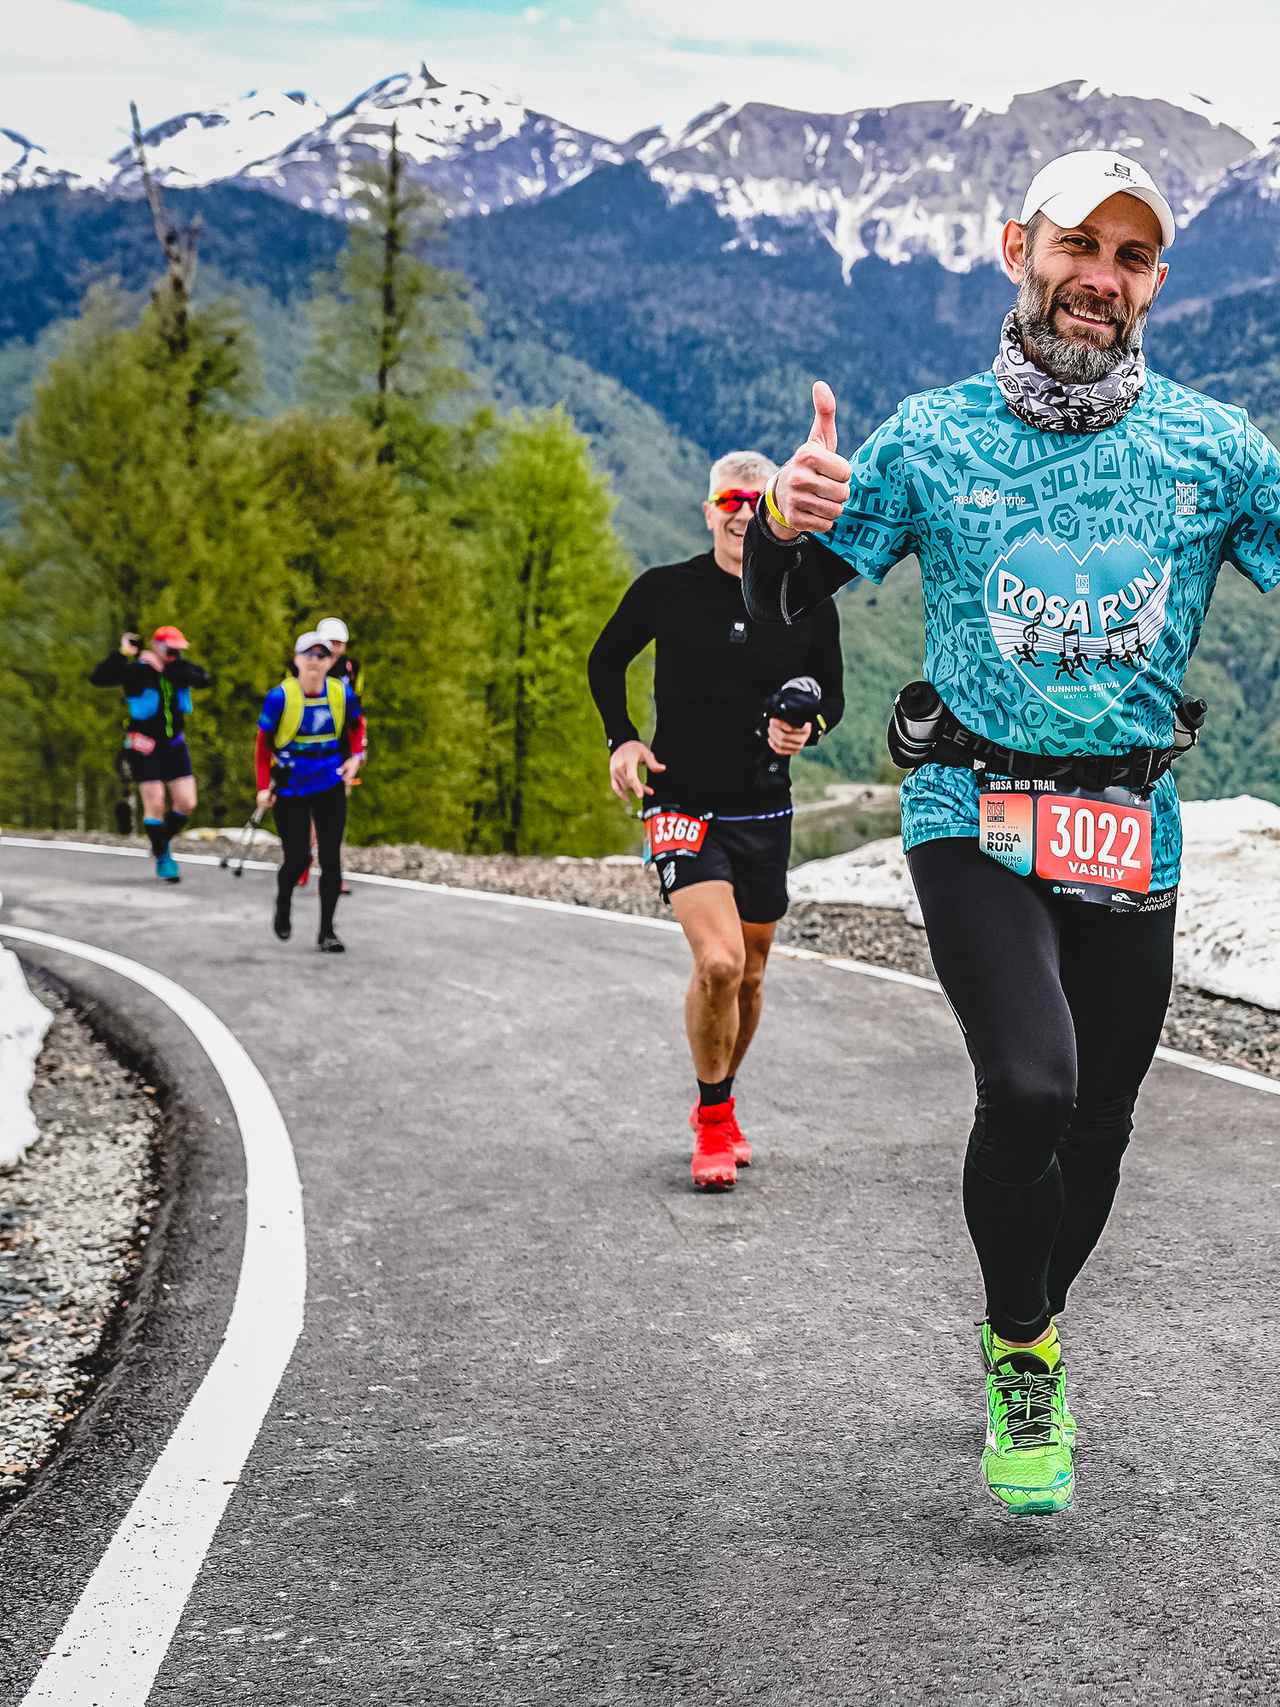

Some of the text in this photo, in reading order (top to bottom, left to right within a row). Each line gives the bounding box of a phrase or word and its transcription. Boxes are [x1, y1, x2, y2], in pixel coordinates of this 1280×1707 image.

[953, 495, 1027, 506] РОЗА ХУТОР
[1175, 487, 1198, 505] ROSA
[1176, 506, 1196, 514] RUN
[997, 567, 1159, 634] ROSA RUN
[1046, 680, 1121, 693] RUNNING FESTIVAL
[989, 779, 1057, 792] ROSA RED TRAIL
[654, 816, 701, 844] 3366
[1049, 804, 1141, 869] 3022
[987, 831, 1021, 843] ROSA
[987, 841, 1014, 853] RUN
[1067, 860, 1126, 881] VASILIY
[1061, 887, 1086, 895] YAPPY
